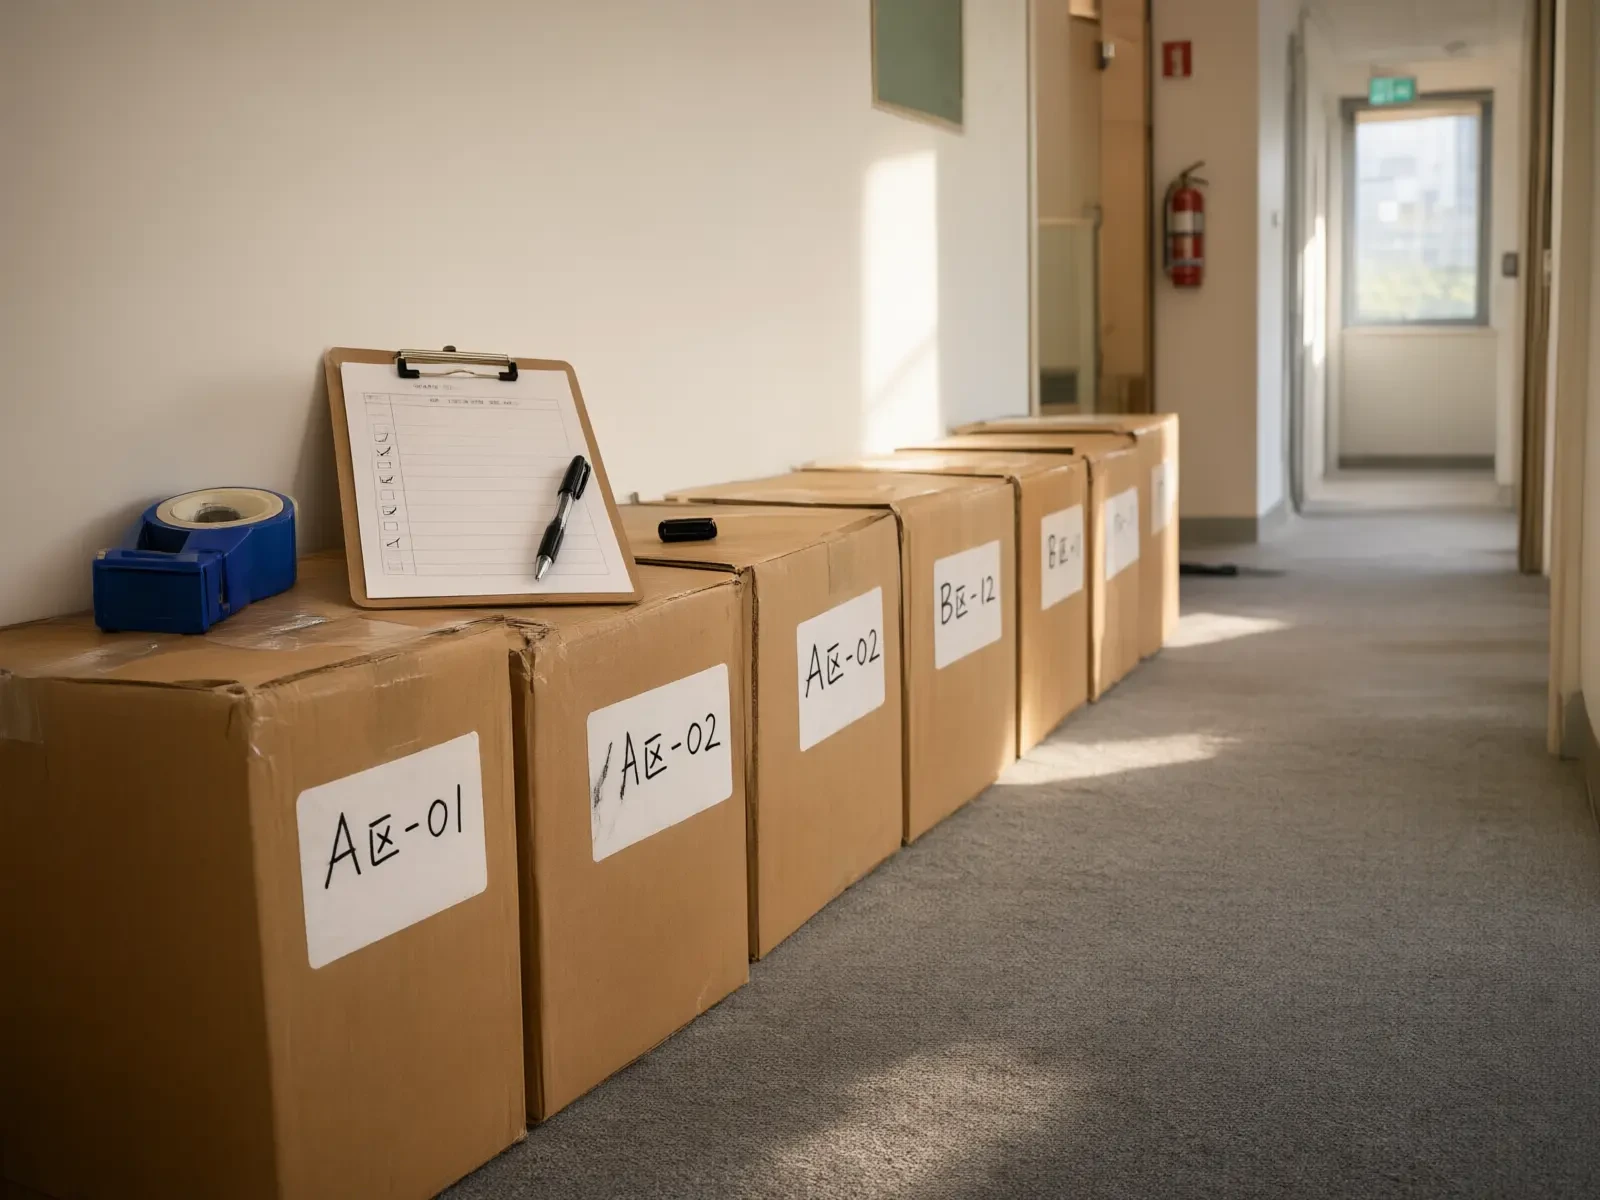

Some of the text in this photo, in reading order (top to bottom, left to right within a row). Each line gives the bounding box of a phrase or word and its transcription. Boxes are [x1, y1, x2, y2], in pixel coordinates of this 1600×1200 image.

[940, 575, 996, 625] B区-12
[805, 629, 881, 698] A区-02
[619, 713, 721, 800] A区-02
[324, 783, 462, 890] A区-01
